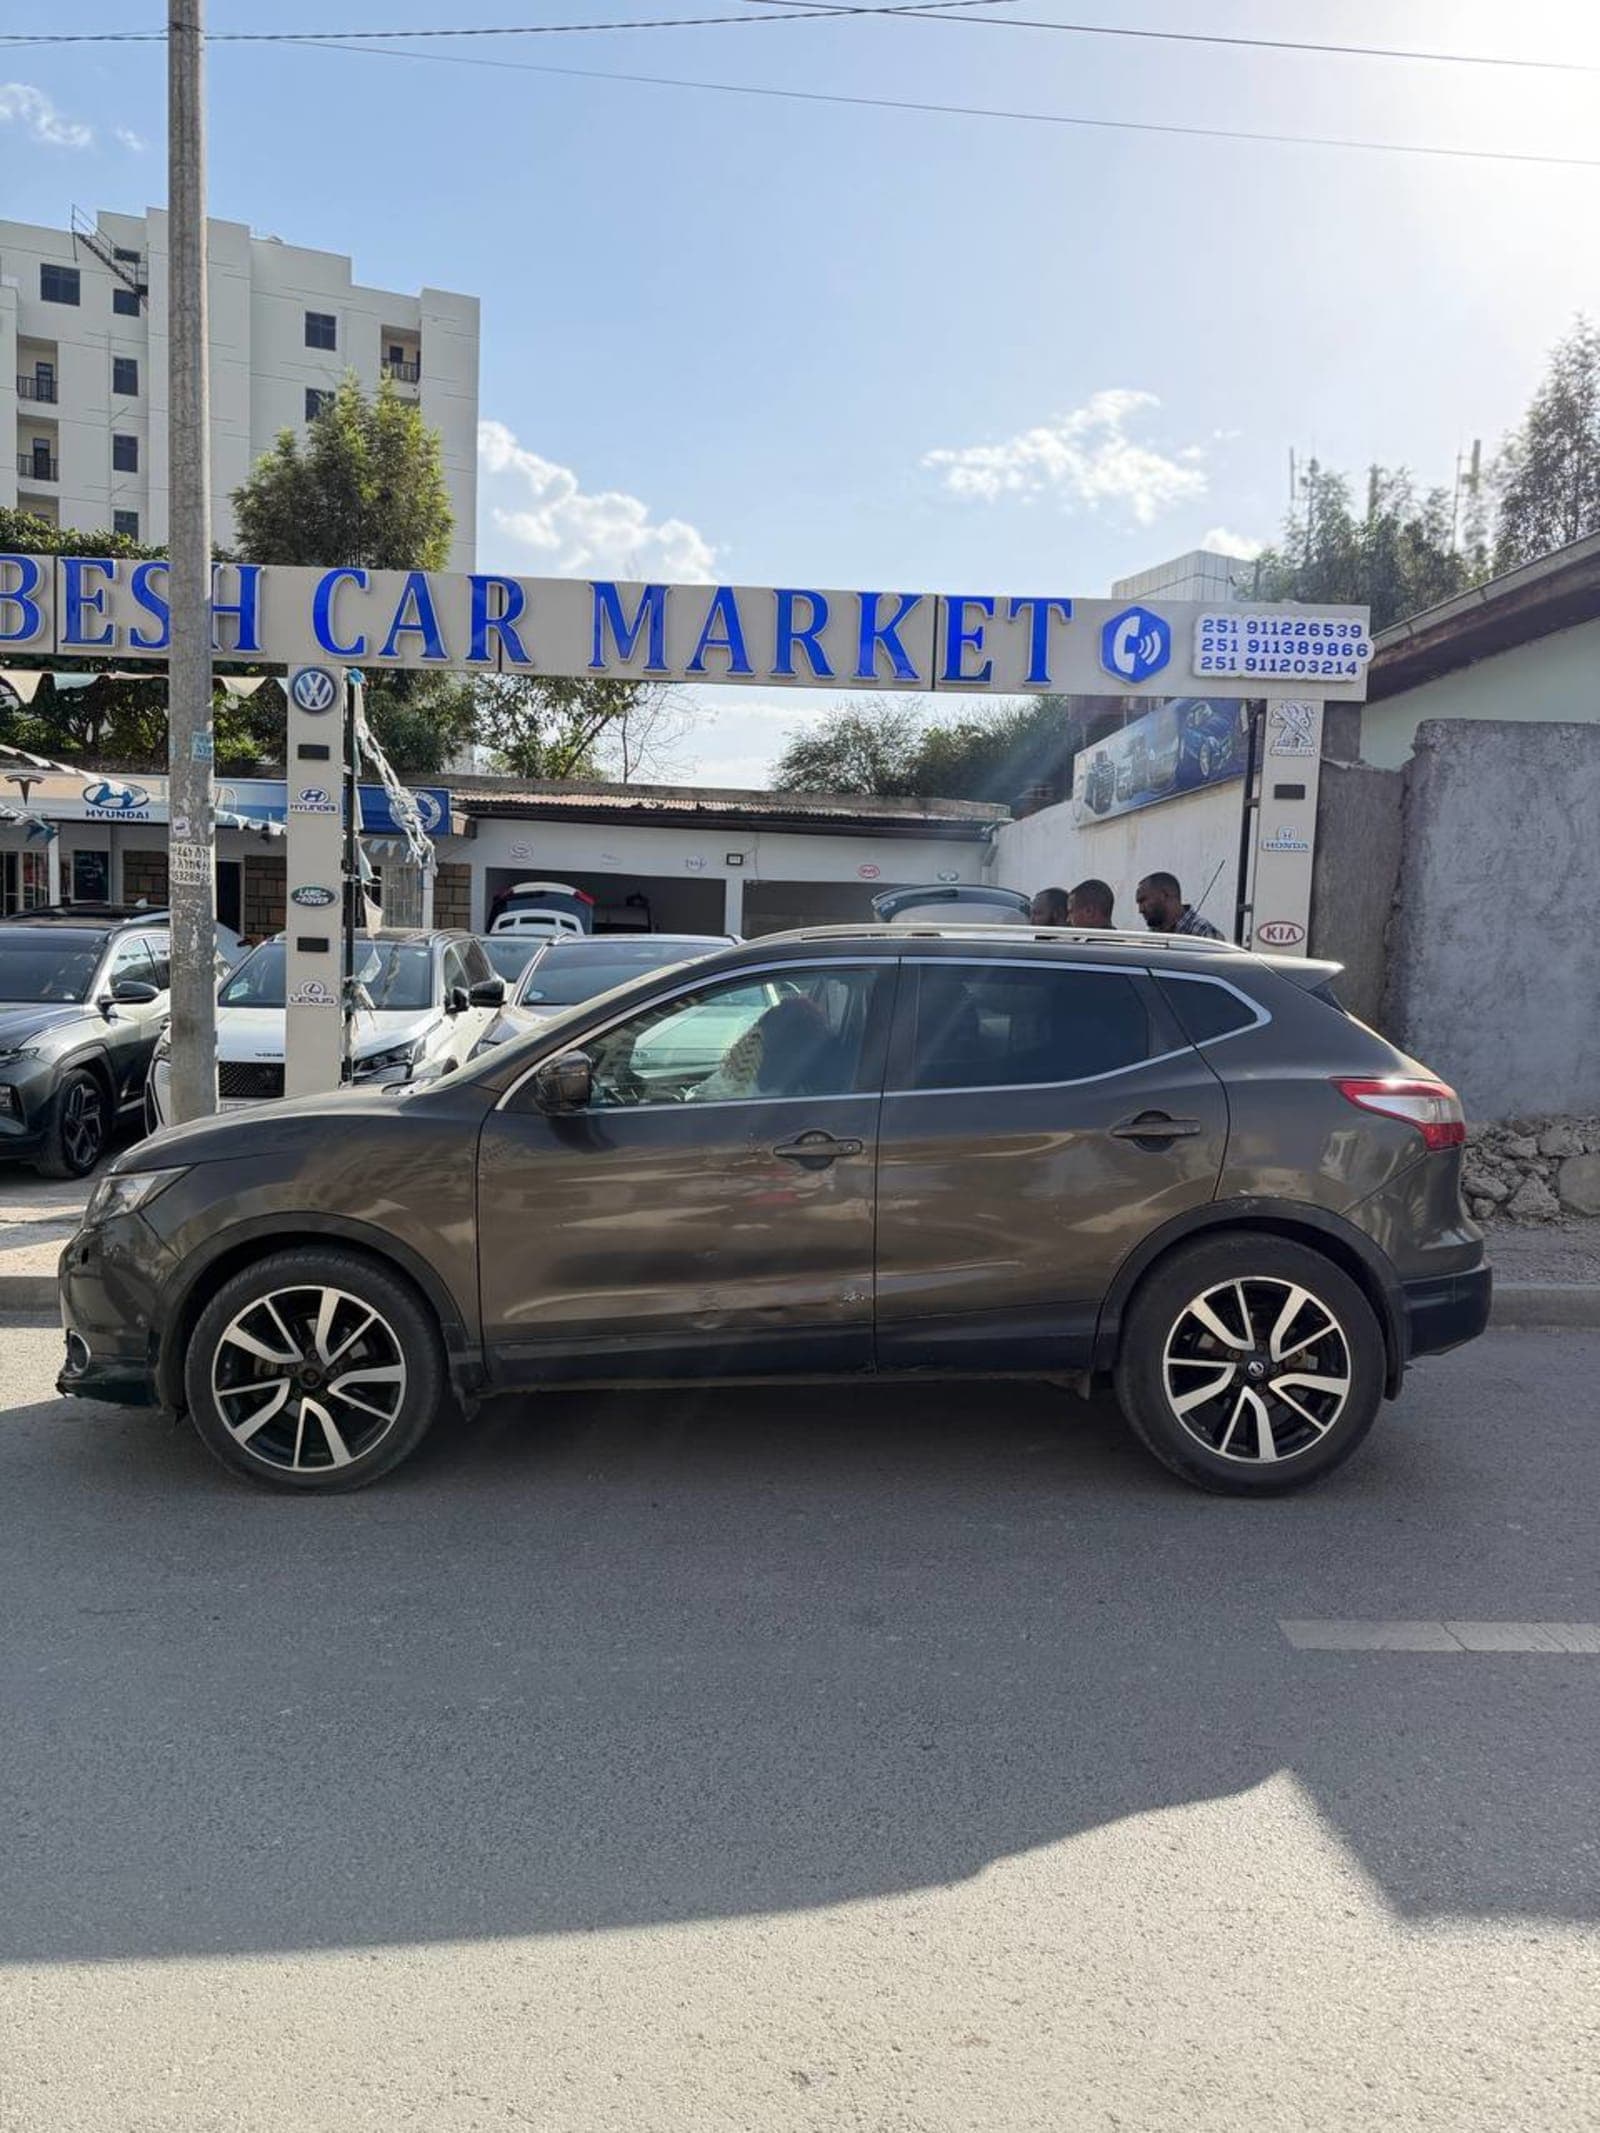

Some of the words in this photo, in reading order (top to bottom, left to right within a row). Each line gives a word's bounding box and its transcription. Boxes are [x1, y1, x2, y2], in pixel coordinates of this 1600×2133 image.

[312, 568, 533, 665] CAR
[587, 580, 1074, 684] MARKET
[1202, 618, 1238, 634] 251
[1247, 620, 1362, 639] 911226539
[1202, 637, 1239, 653] 251
[1248, 639, 1369, 658] 911389866
[1200, 656, 1237, 671] 251
[1245, 657, 1358, 675] 911203214
[85, 809, 150, 819] HYUNDAI
[1266, 927, 1297, 940] KIA
